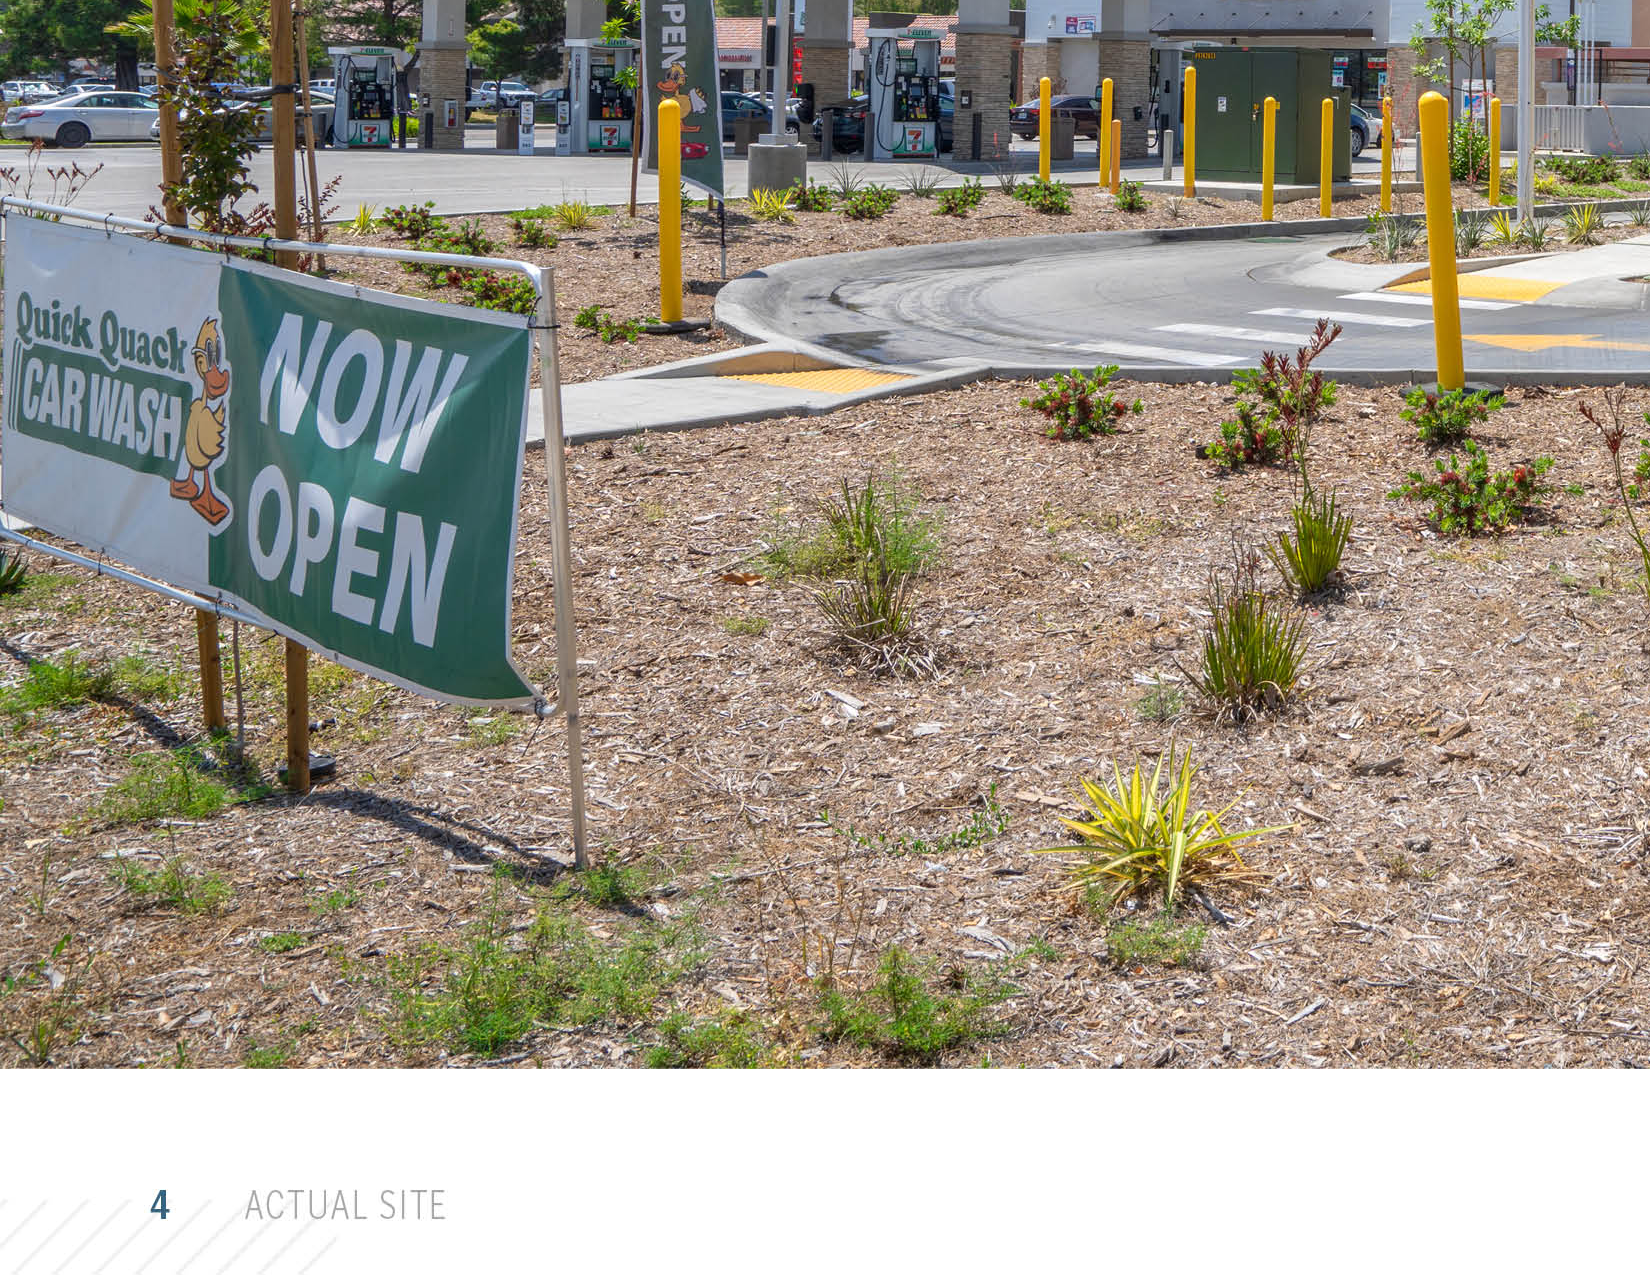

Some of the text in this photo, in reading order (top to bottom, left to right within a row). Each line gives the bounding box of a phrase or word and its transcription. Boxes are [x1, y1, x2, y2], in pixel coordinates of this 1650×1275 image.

[16, 290, 188, 374] Quick Quack
[260, 311, 470, 475] NOW
[22, 356, 183, 463] CAR WASH
[247, 463, 458, 649] OPEN
